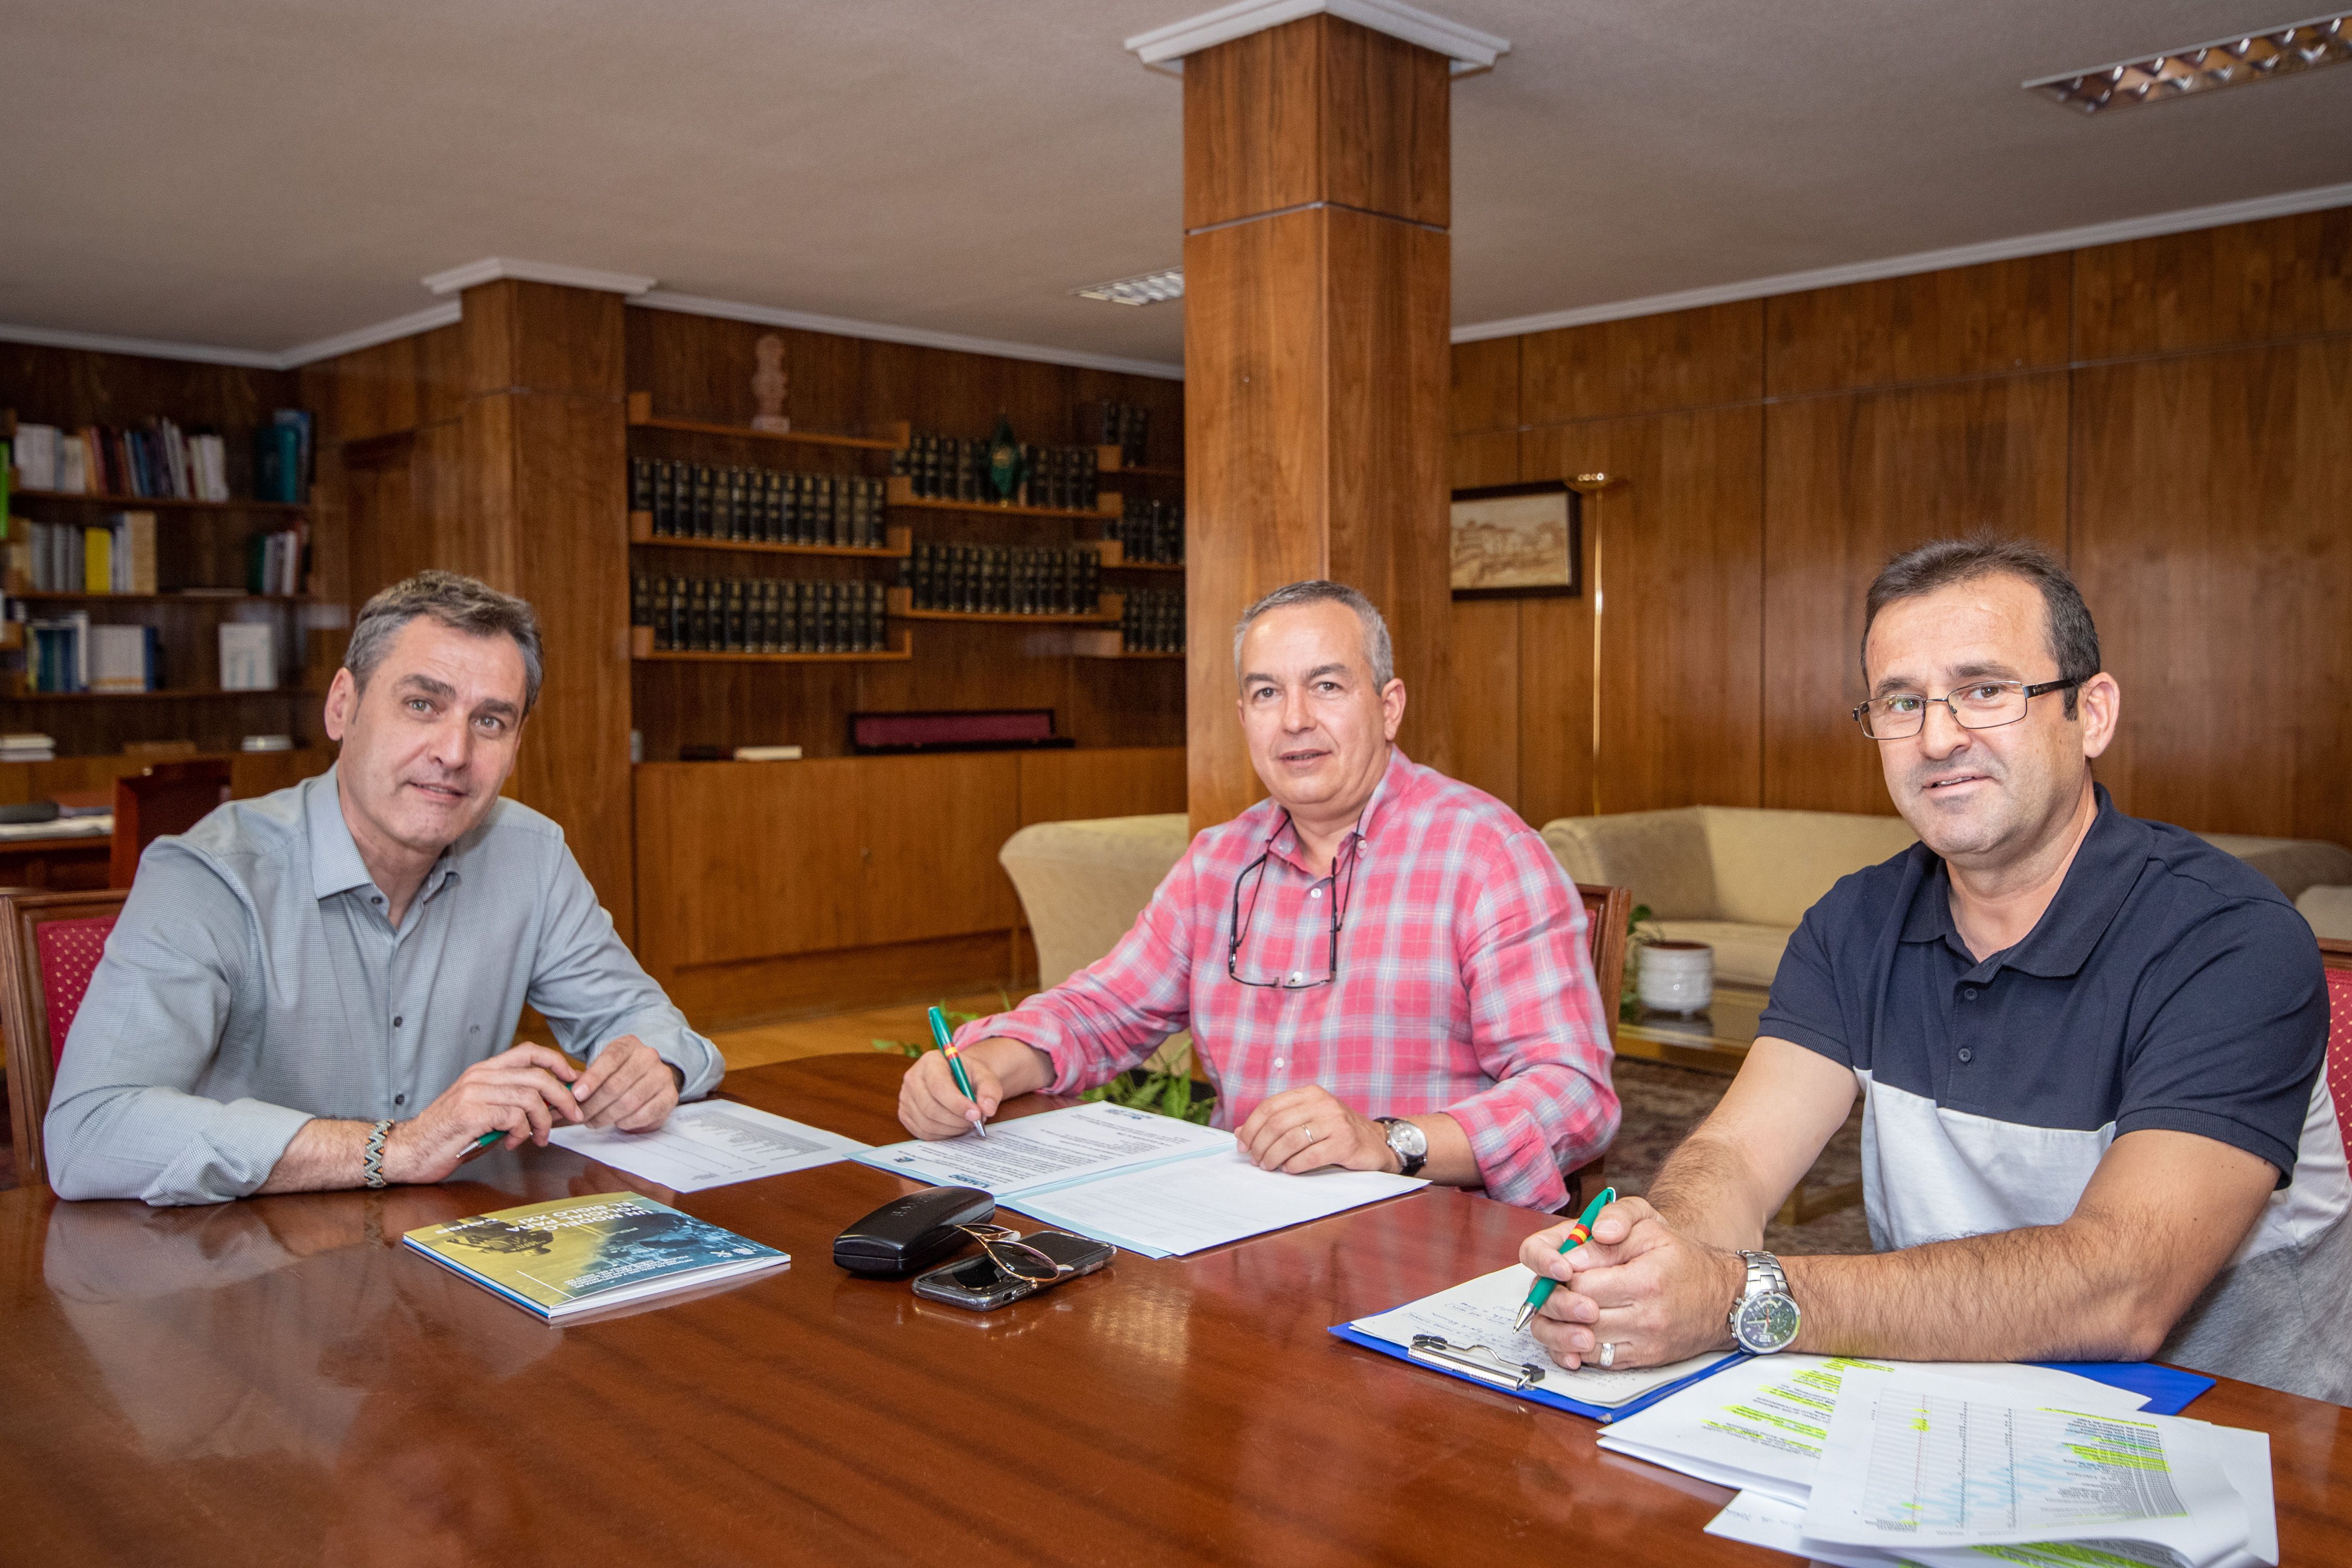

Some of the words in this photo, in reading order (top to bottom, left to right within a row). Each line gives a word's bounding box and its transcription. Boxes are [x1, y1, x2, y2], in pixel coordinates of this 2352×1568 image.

[552, 1205, 608, 1217] SIGLO
[559, 1206, 643, 1220] POLICIAL
[505, 1219, 558, 1232] PARA
[517, 1214, 551, 1224] XXI
[543, 1213, 624, 1231] MODELO
